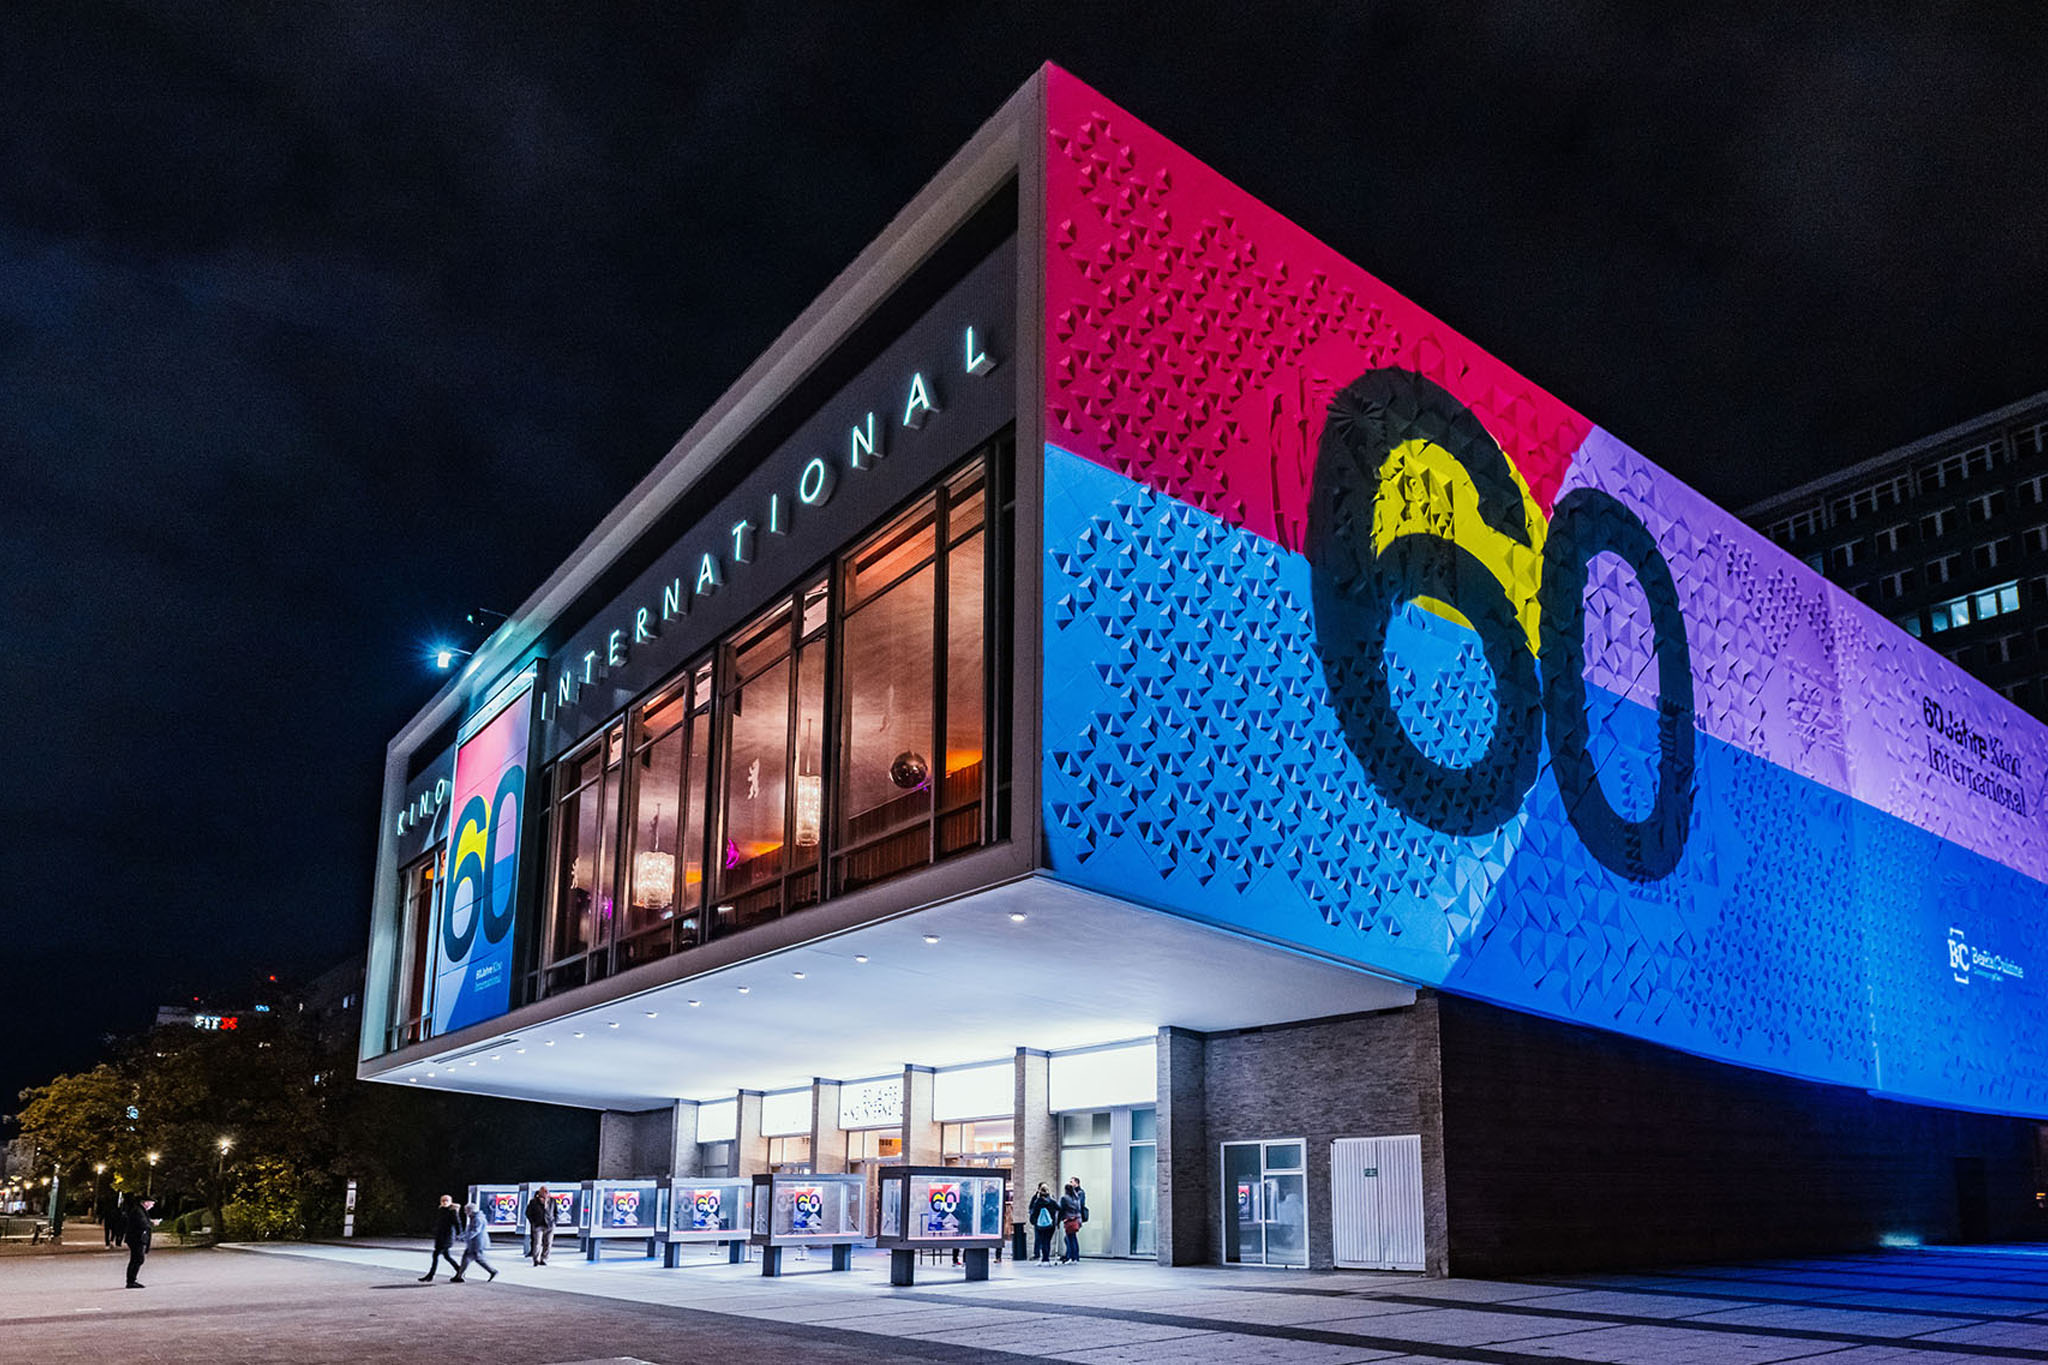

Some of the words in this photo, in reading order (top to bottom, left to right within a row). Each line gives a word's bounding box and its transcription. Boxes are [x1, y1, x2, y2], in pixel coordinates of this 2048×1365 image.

[540, 326, 987, 721] INTERNATIONAL
[1307, 366, 1695, 881] 60
[1922, 696, 1944, 734] 60
[397, 778, 447, 836] KINO
[443, 764, 524, 962] 60
[1947, 938, 1970, 972] BC
[616, 1197, 638, 1212] 60
[696, 1195, 719, 1213] 60
[796, 1193, 820, 1213] 60
[931, 1191, 957, 1213] 60
